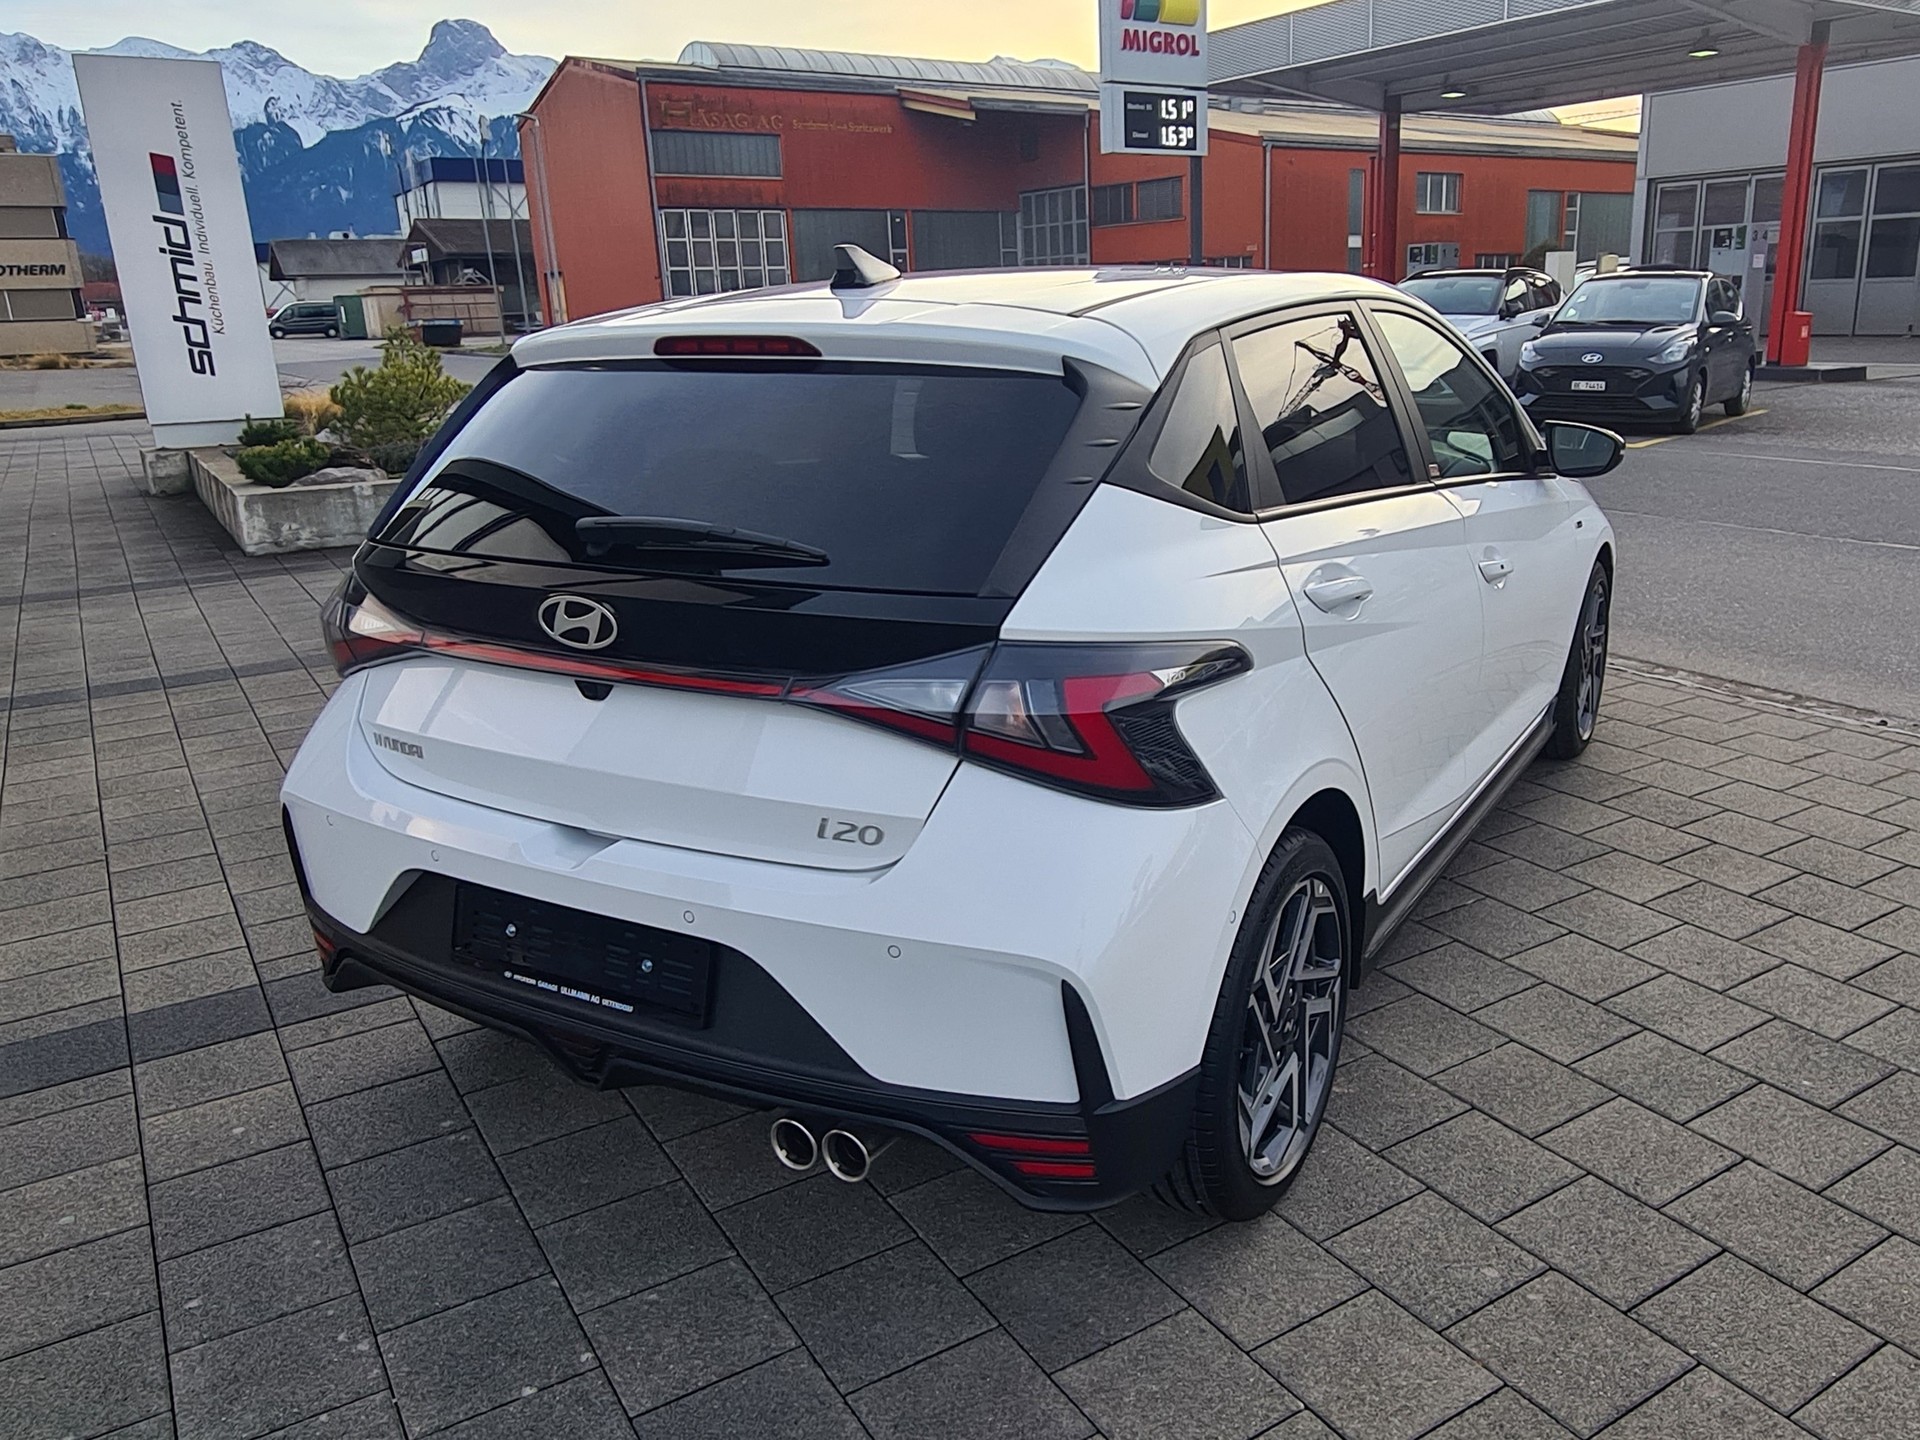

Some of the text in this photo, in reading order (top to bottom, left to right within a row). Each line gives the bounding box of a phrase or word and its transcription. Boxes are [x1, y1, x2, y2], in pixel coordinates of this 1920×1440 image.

[1121, 28, 1200, 57] MIGROL
[756, 113, 783, 130] AG
[170, 99, 225, 335] Küchenbau. Individuell. Kompetent.
[152, 214, 217, 377] schmid
[373, 731, 424, 759] HYUNDAI
[590, 994, 601, 1004] AG
